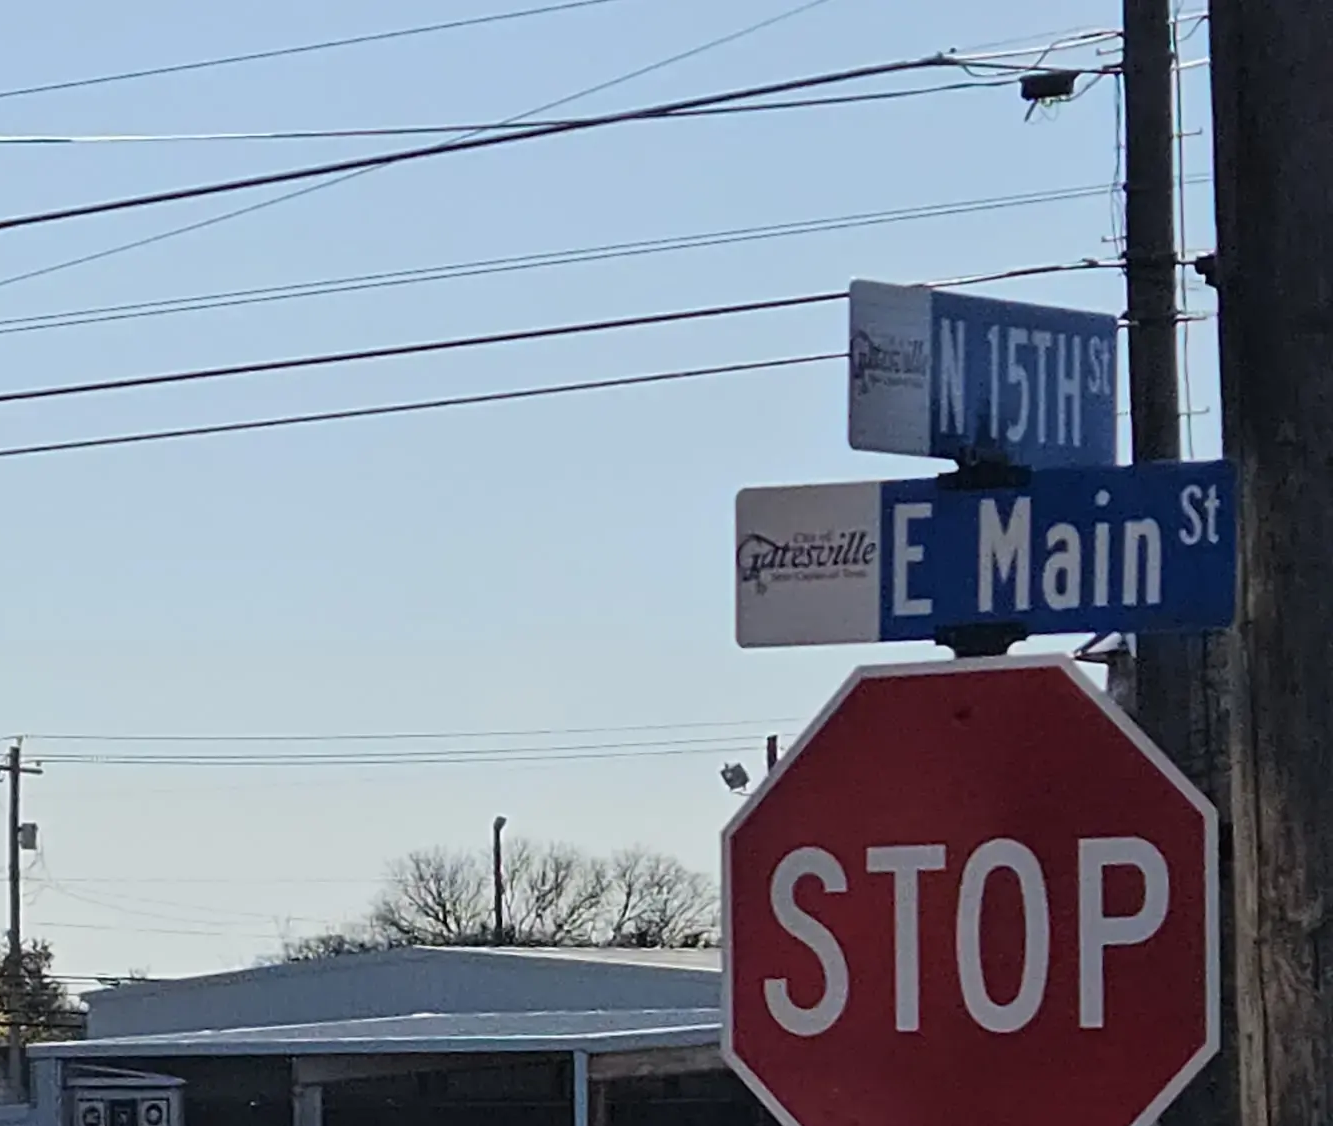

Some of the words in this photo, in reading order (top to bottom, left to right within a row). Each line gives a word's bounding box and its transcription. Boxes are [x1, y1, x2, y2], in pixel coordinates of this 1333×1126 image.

[939, 318, 965, 434] N
[988, 323, 1082, 448] 15TH
[1088, 335, 1112, 396] St
[736, 530, 877, 582] Gatesville
[893, 502, 933, 616] E
[978, 490, 1162, 614] Main
[1178, 484, 1220, 546] St
[763, 837, 1170, 1037] STOP
